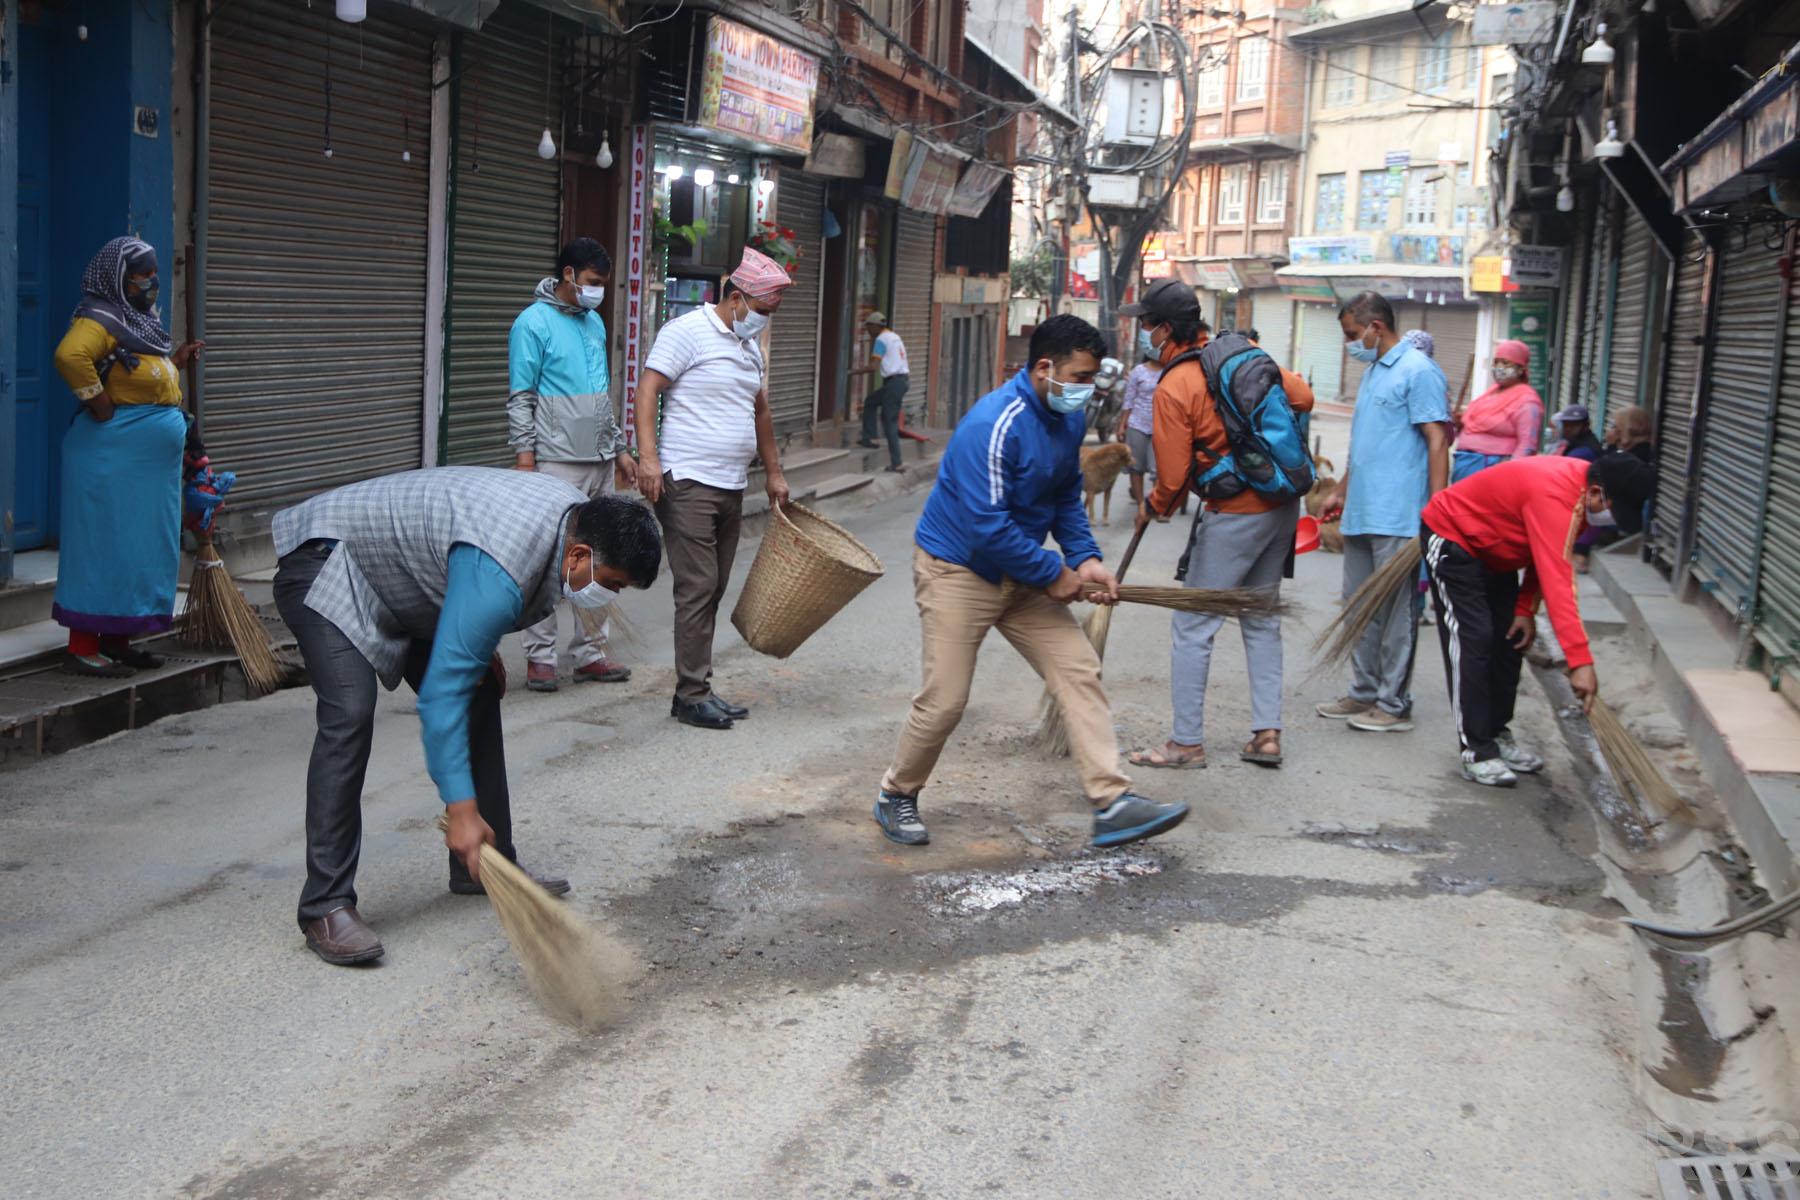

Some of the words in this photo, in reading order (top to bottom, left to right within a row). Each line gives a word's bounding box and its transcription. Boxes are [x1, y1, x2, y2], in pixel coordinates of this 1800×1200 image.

[719, 22, 738, 56] TOP
[754, 38, 779, 71] TOWN
[780, 46, 814, 85] BAKERY
